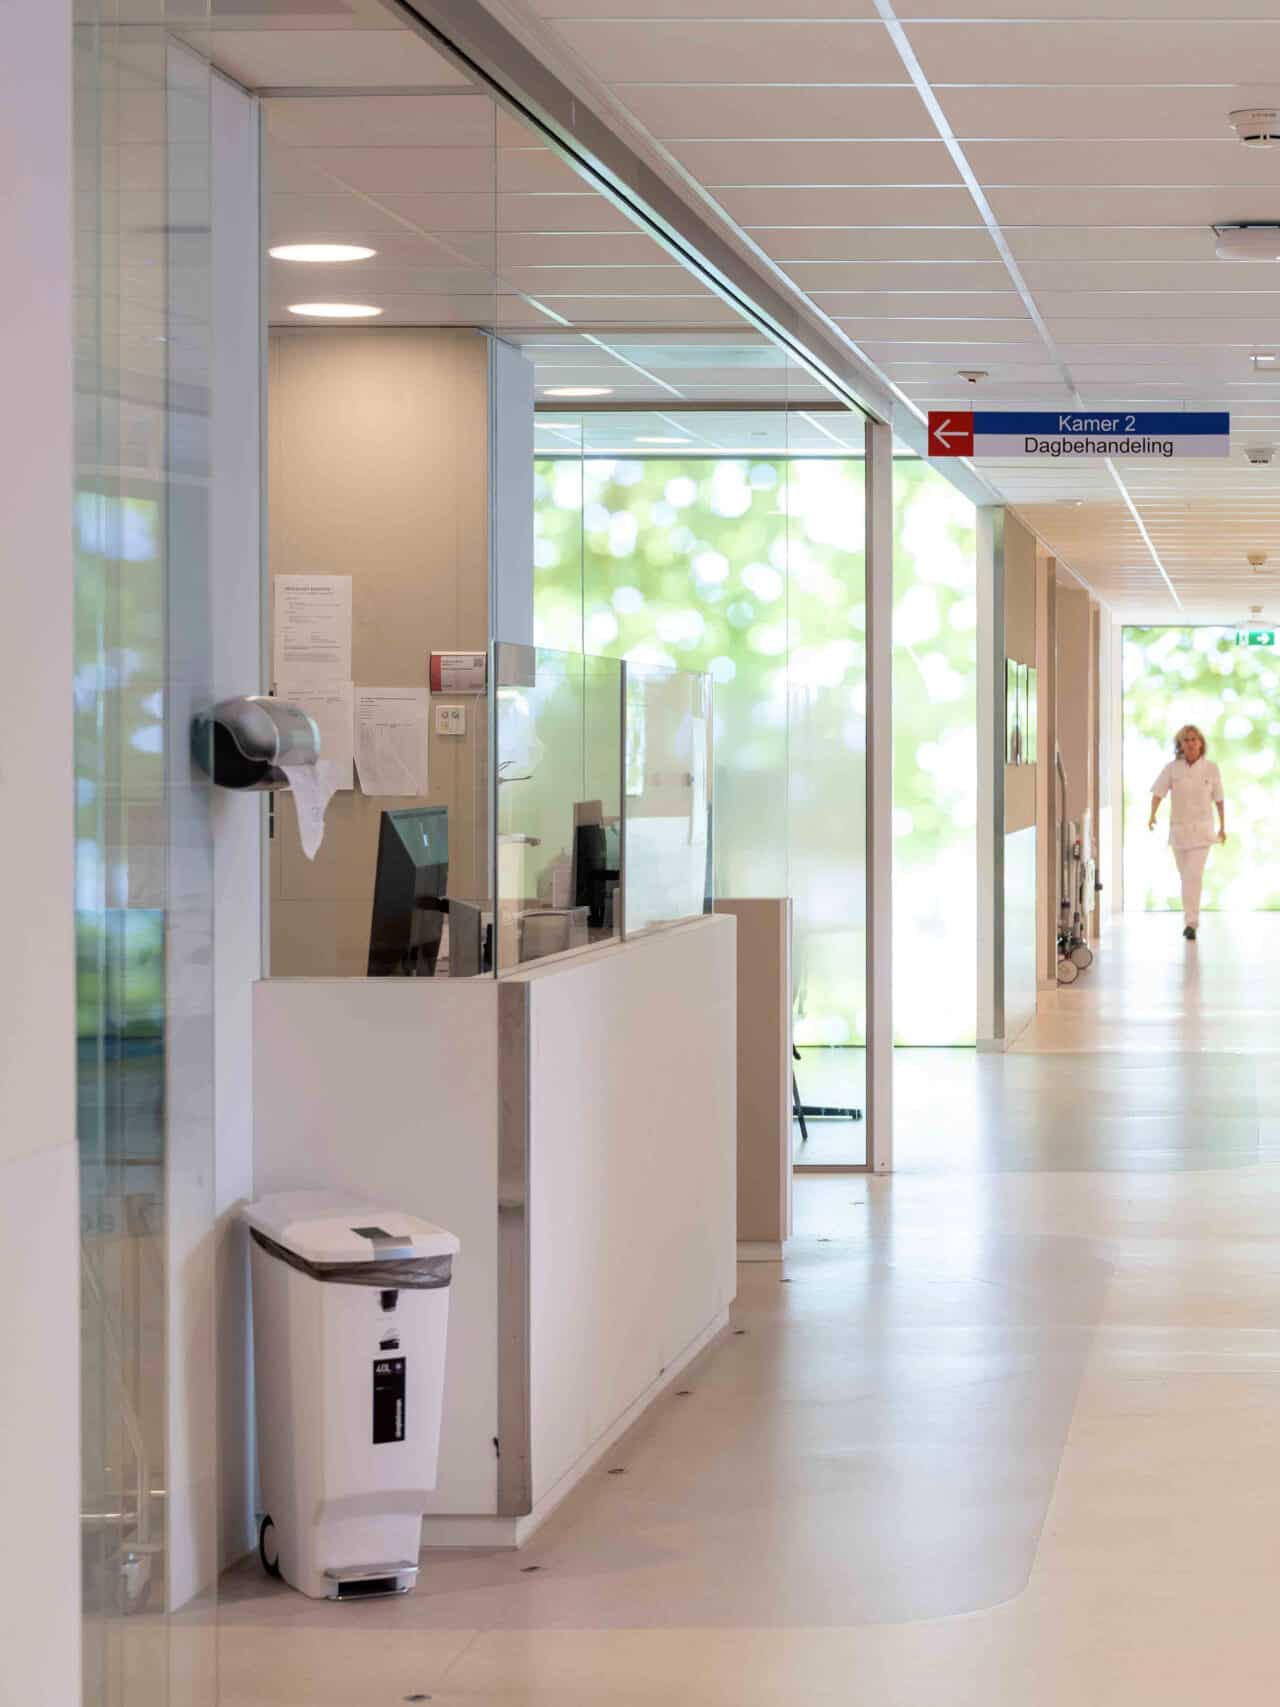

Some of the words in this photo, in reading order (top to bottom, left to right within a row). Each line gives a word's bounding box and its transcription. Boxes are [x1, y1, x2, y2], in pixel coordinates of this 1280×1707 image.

[1058, 415, 1119, 432] Kamer
[1124, 415, 1136, 432] 2
[1024, 436, 1174, 457] Dagbehandeling
